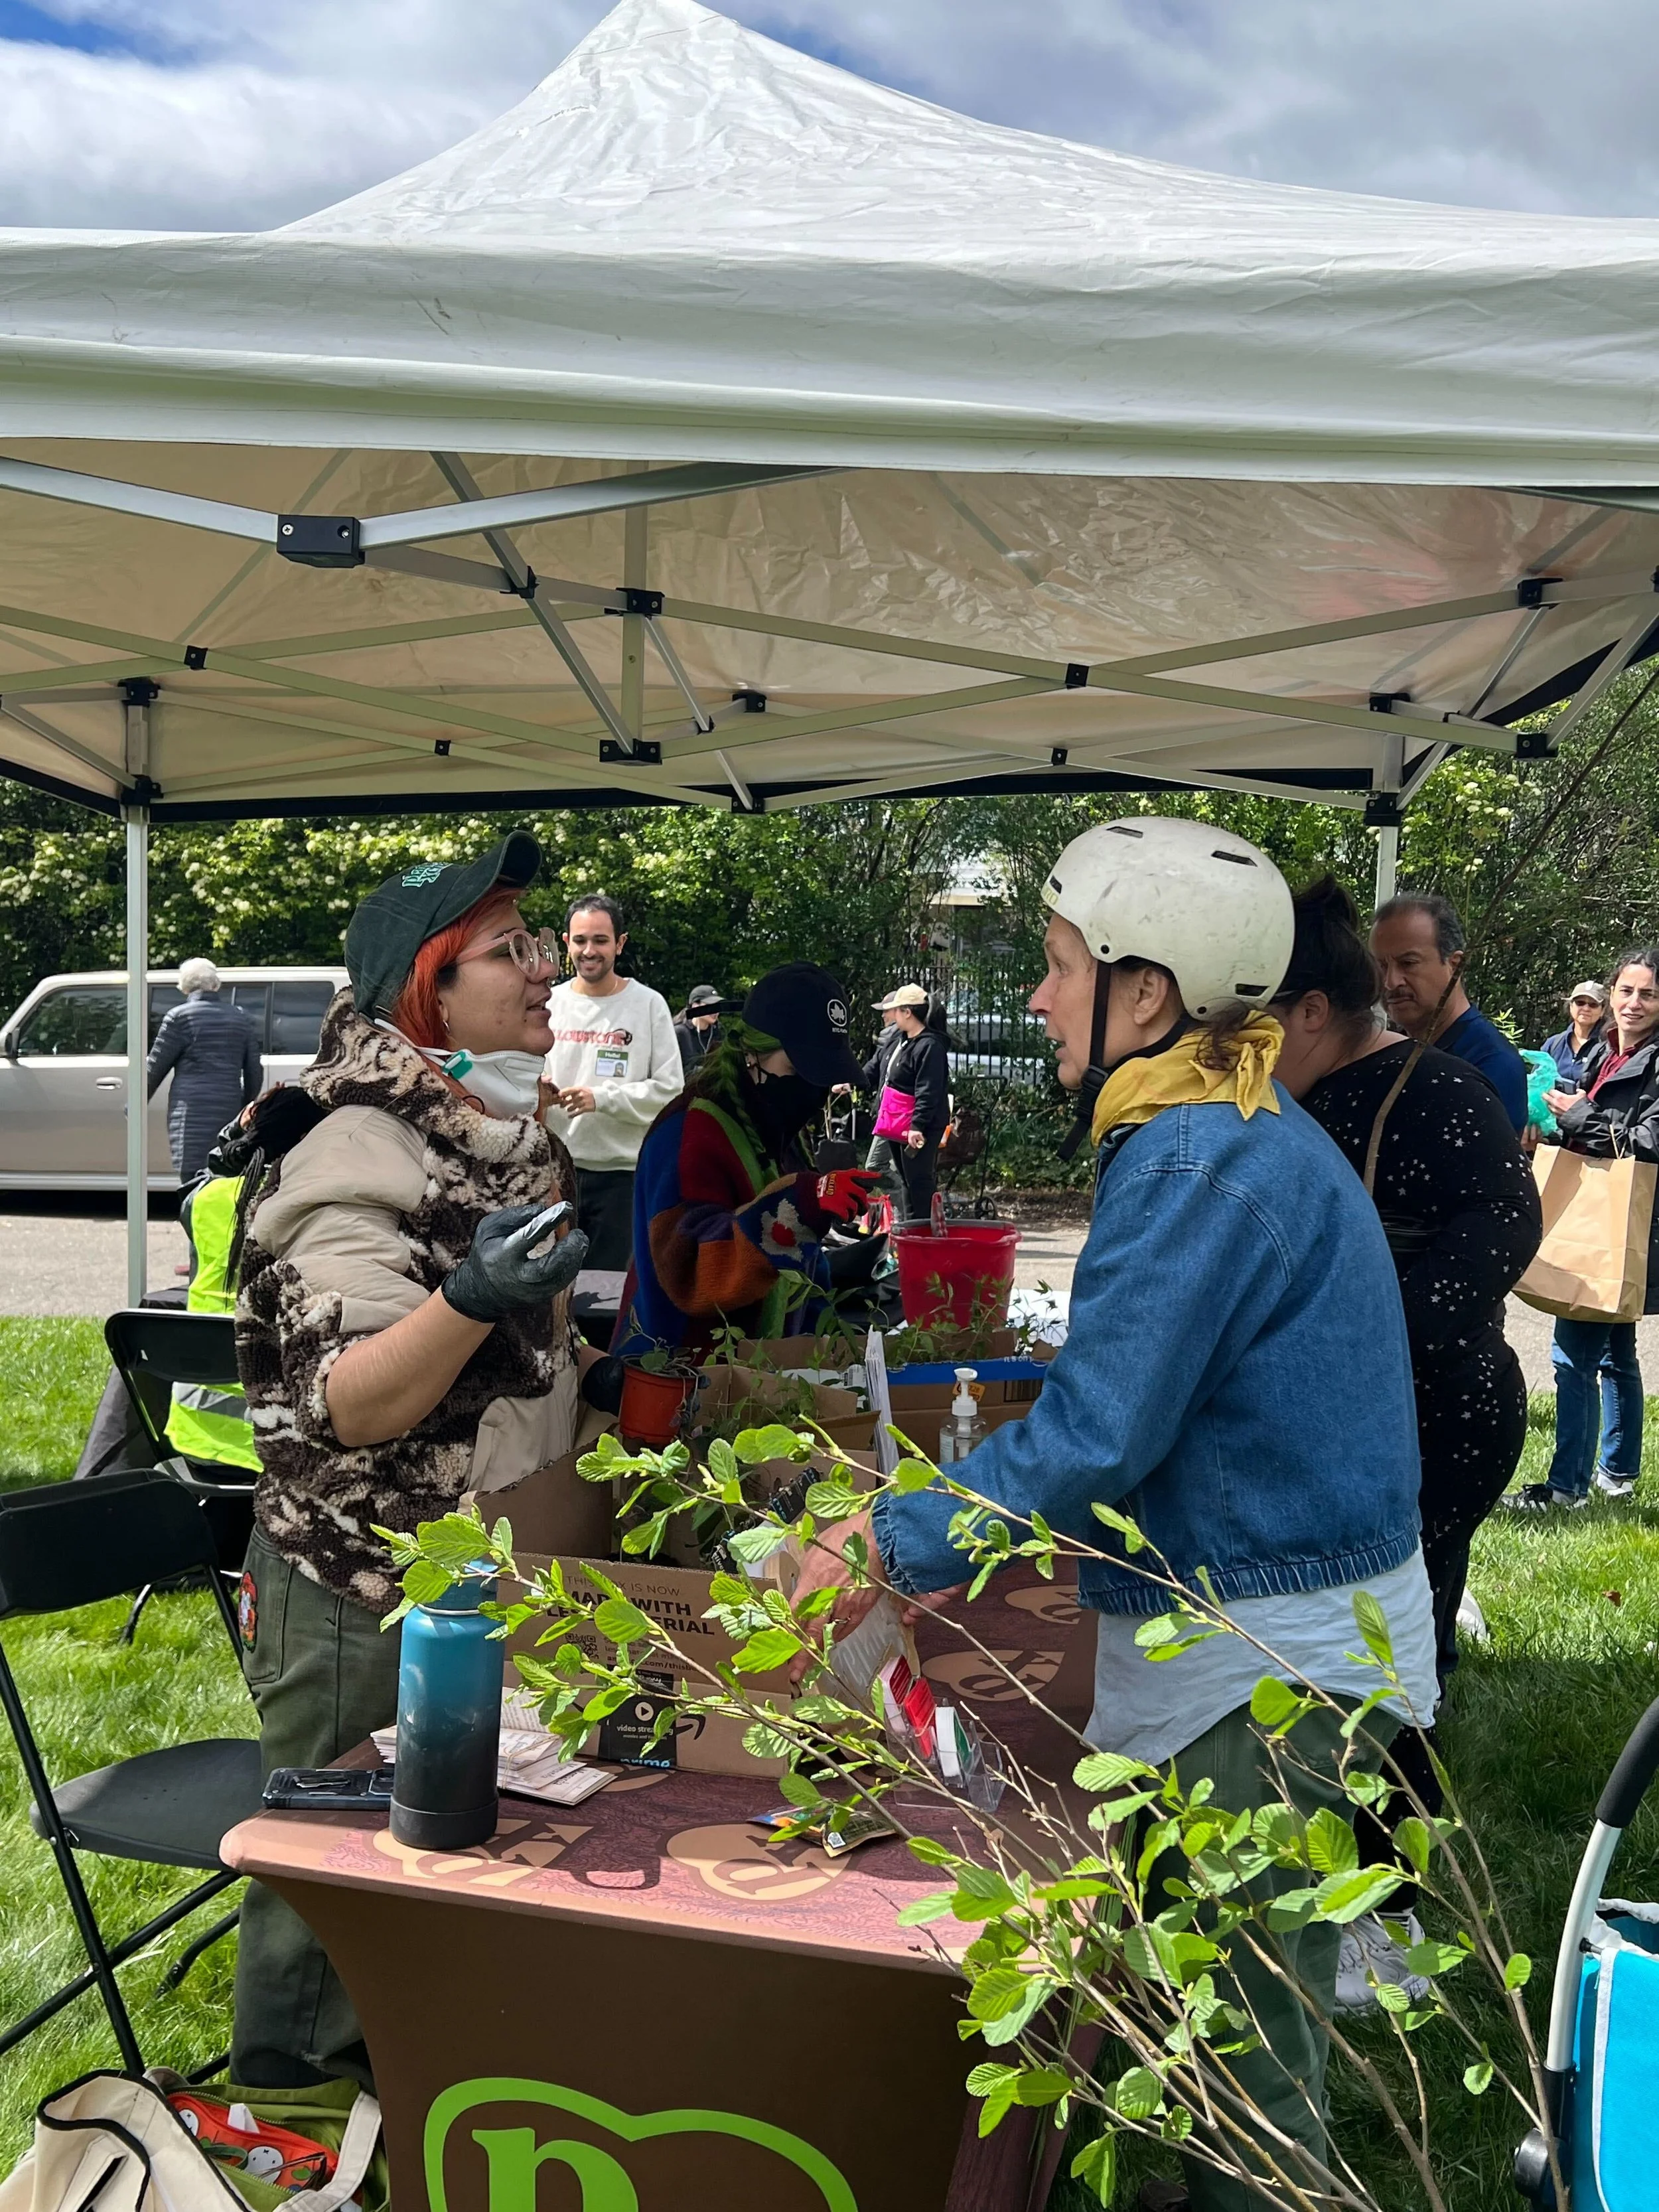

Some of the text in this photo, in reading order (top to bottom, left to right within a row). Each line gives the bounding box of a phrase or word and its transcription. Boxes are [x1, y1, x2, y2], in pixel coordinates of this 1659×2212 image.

[631, 1584, 643, 1592] IS
[646, 1585, 680, 1596] NOW
[571, 1591, 691, 1616] MAD WITH
[653, 1617, 715, 1636] ERIAL
[637, 1726, 674, 1735] streag
